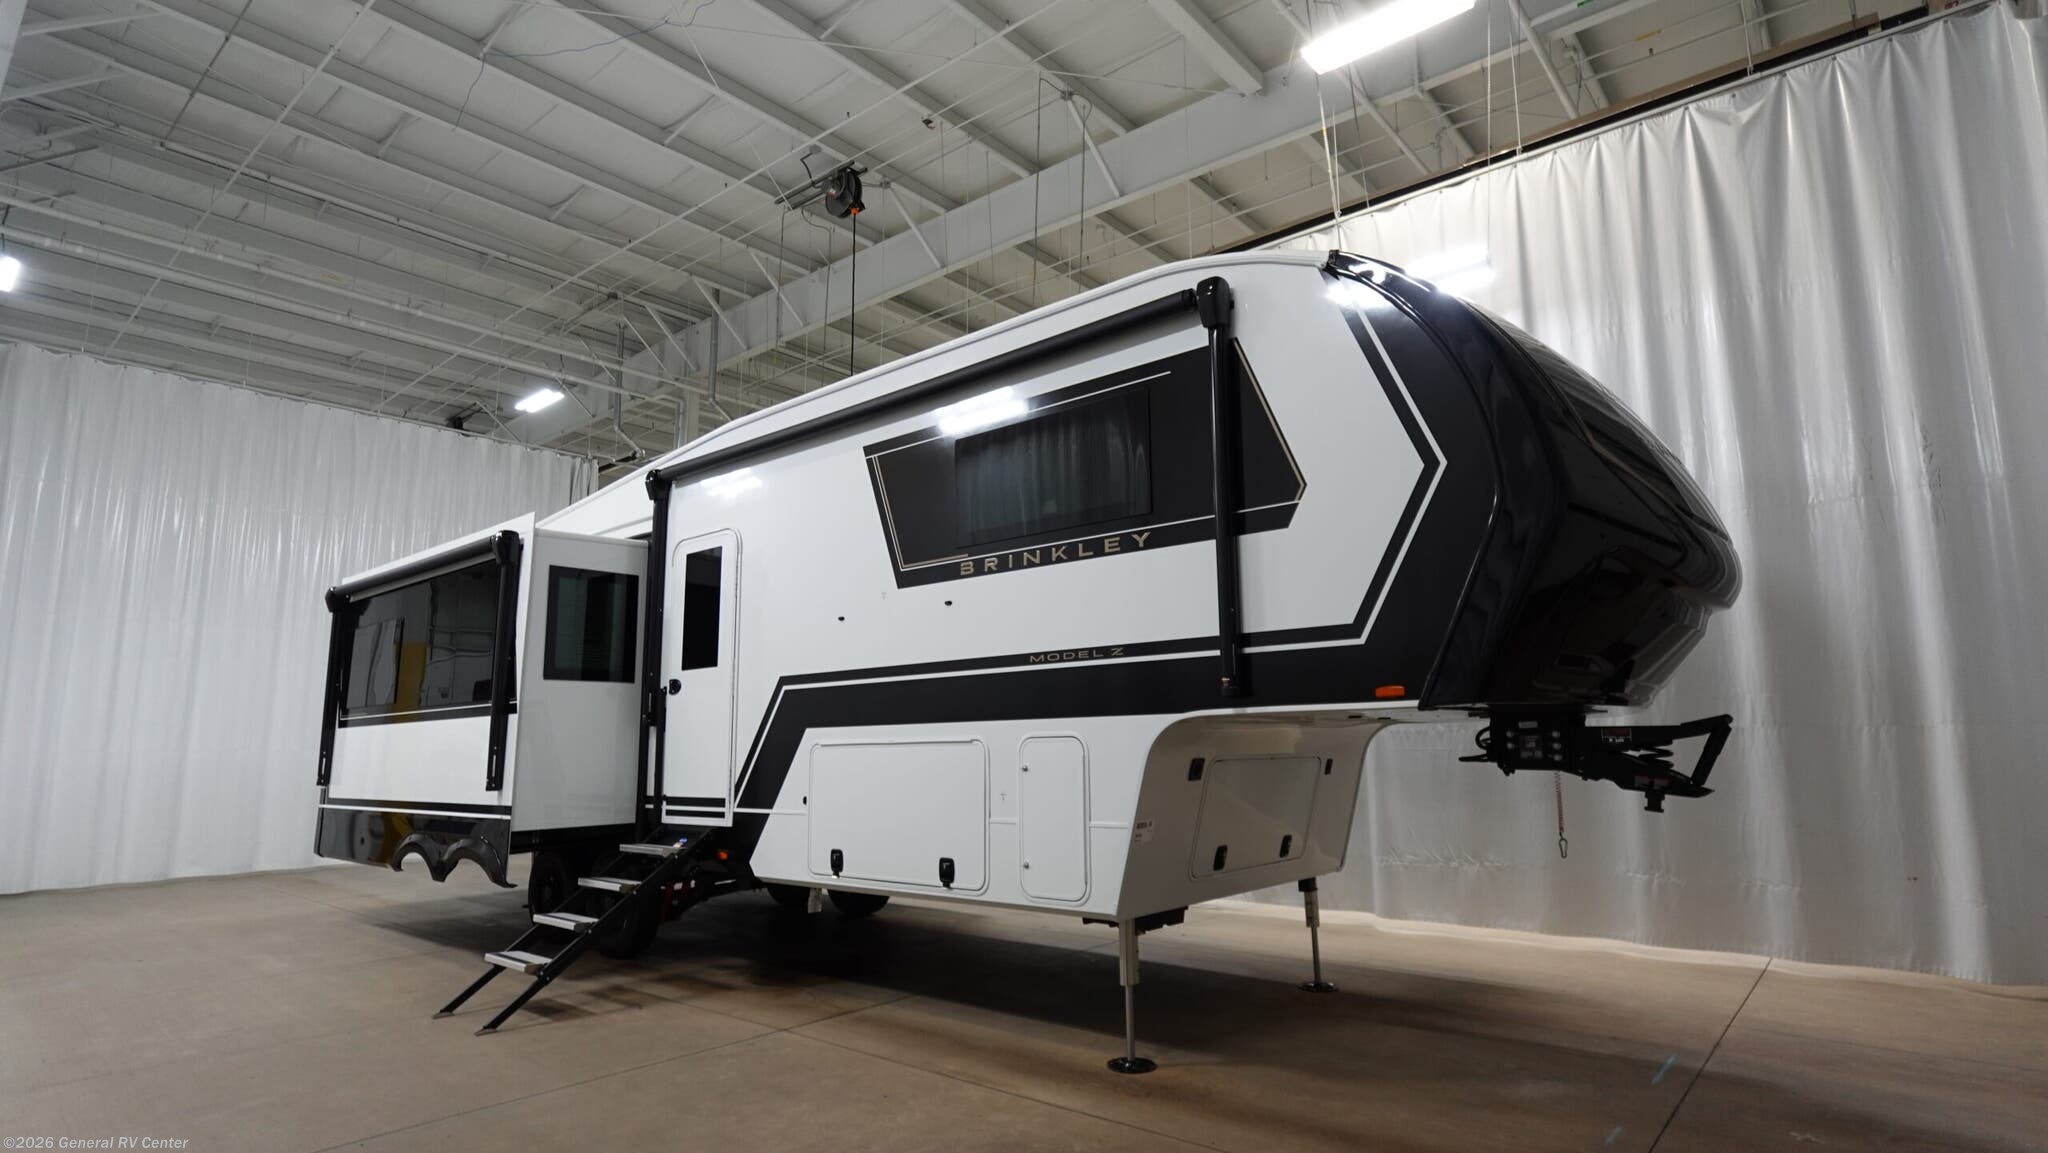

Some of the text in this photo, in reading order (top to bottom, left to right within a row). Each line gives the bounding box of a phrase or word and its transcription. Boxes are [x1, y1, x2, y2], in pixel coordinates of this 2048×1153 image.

[960, 532, 1150, 576] BRINKLEY
[1029, 647, 1124, 663] MODEL Z
